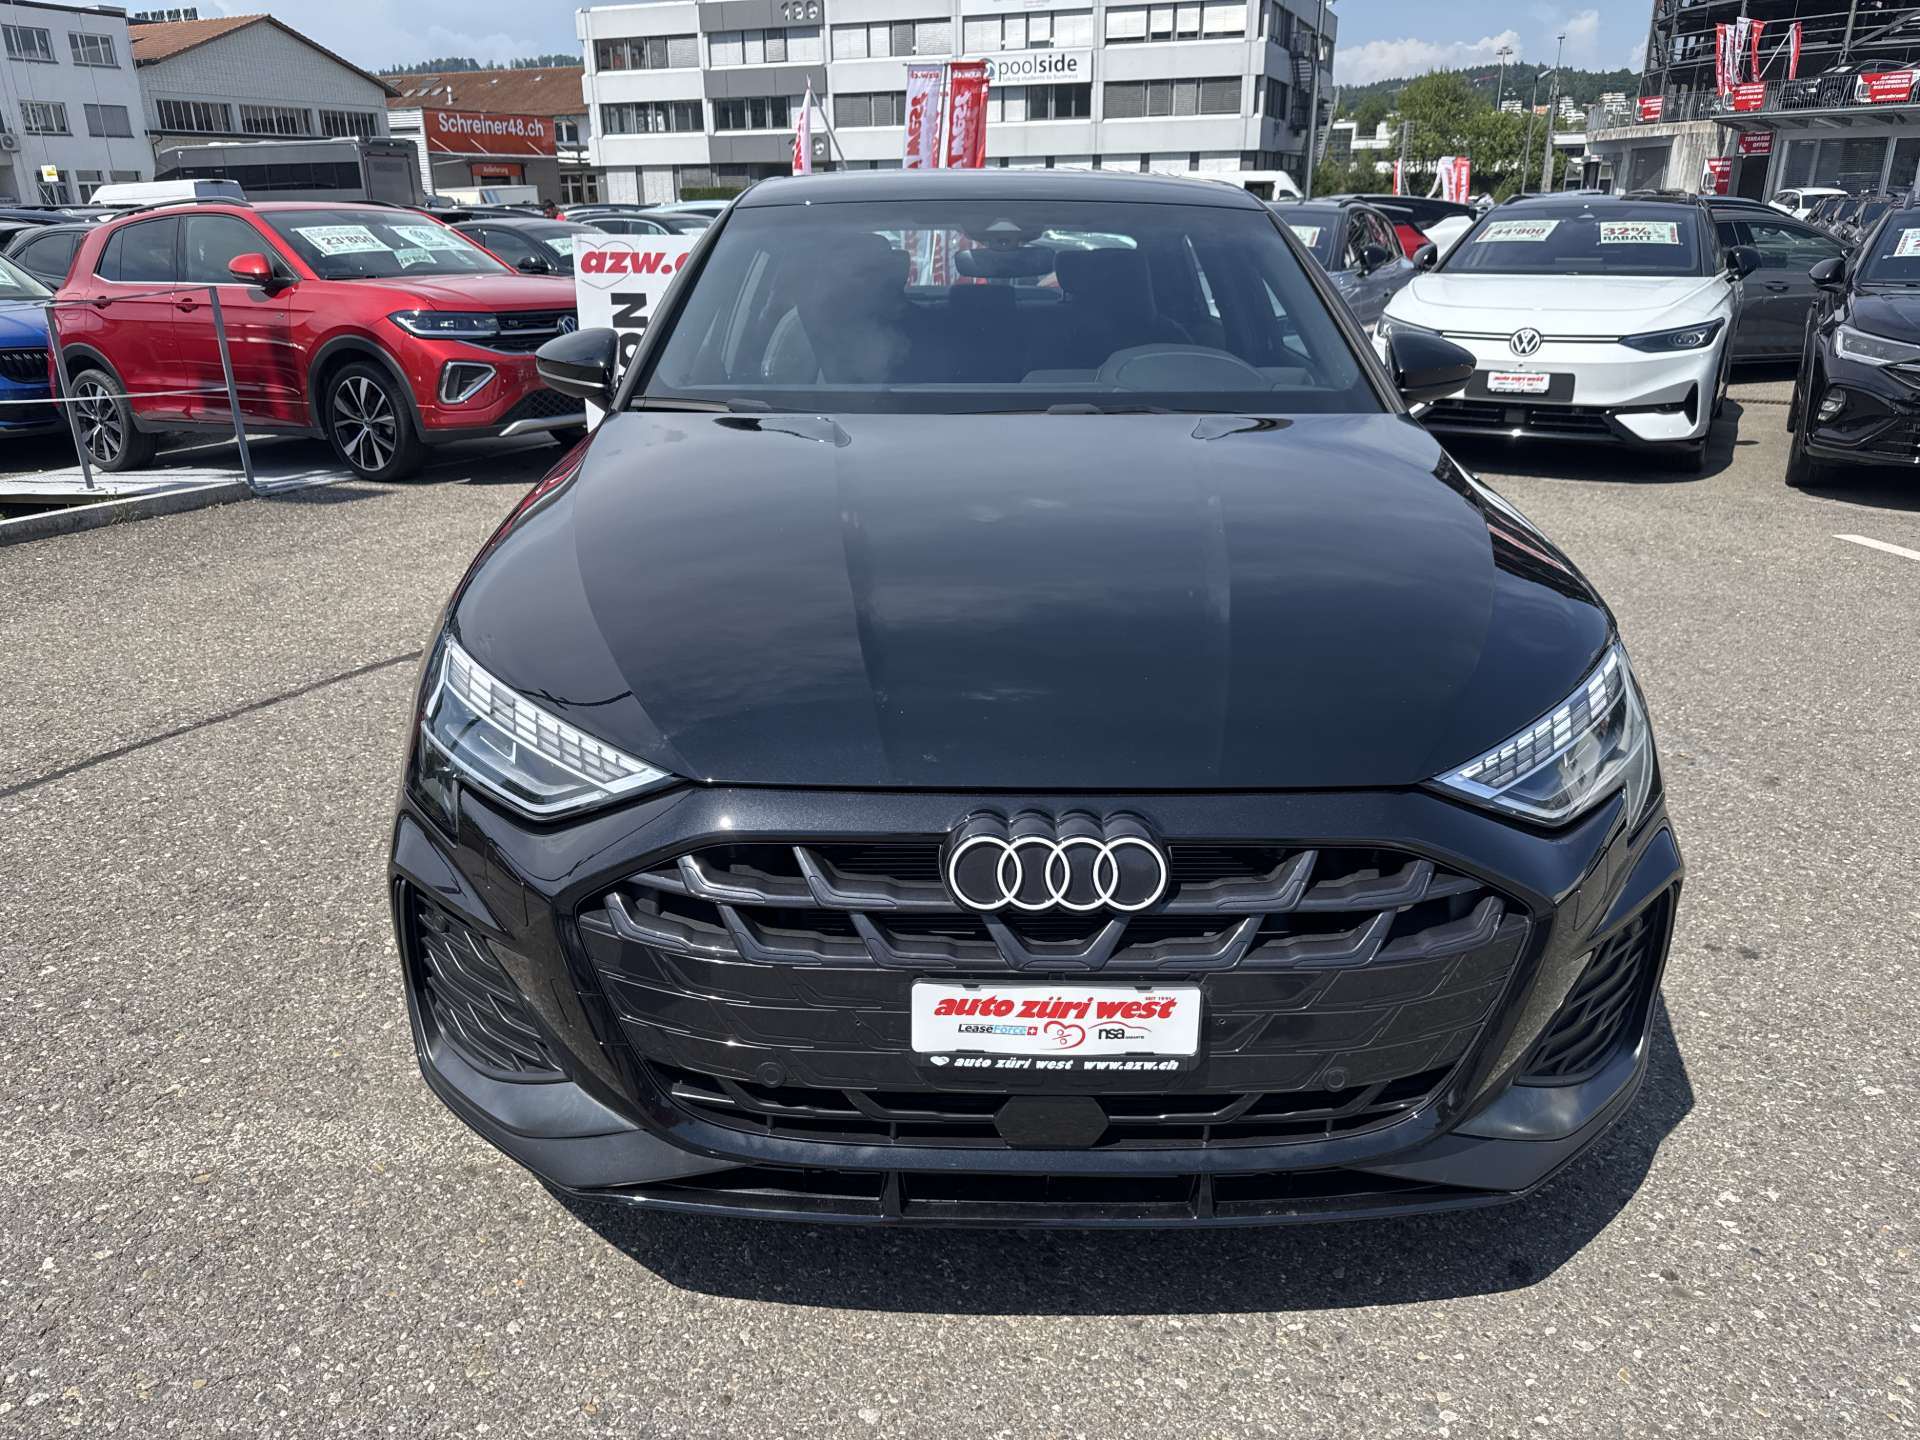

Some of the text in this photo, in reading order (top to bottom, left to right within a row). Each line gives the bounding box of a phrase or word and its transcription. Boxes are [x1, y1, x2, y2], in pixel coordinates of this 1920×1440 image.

[999, 54, 1078, 82] poolside
[438, 112, 545, 137] Schreiner48.ch
[1602, 227, 1652, 236] 32%
[933, 995, 1178, 1019] auto züri west
[957, 1023, 1027, 1036] LeaseForce
[1098, 1028, 1125, 1040] nsa
[954, 1057, 1179, 1072] auto züri west www.azw.ch
